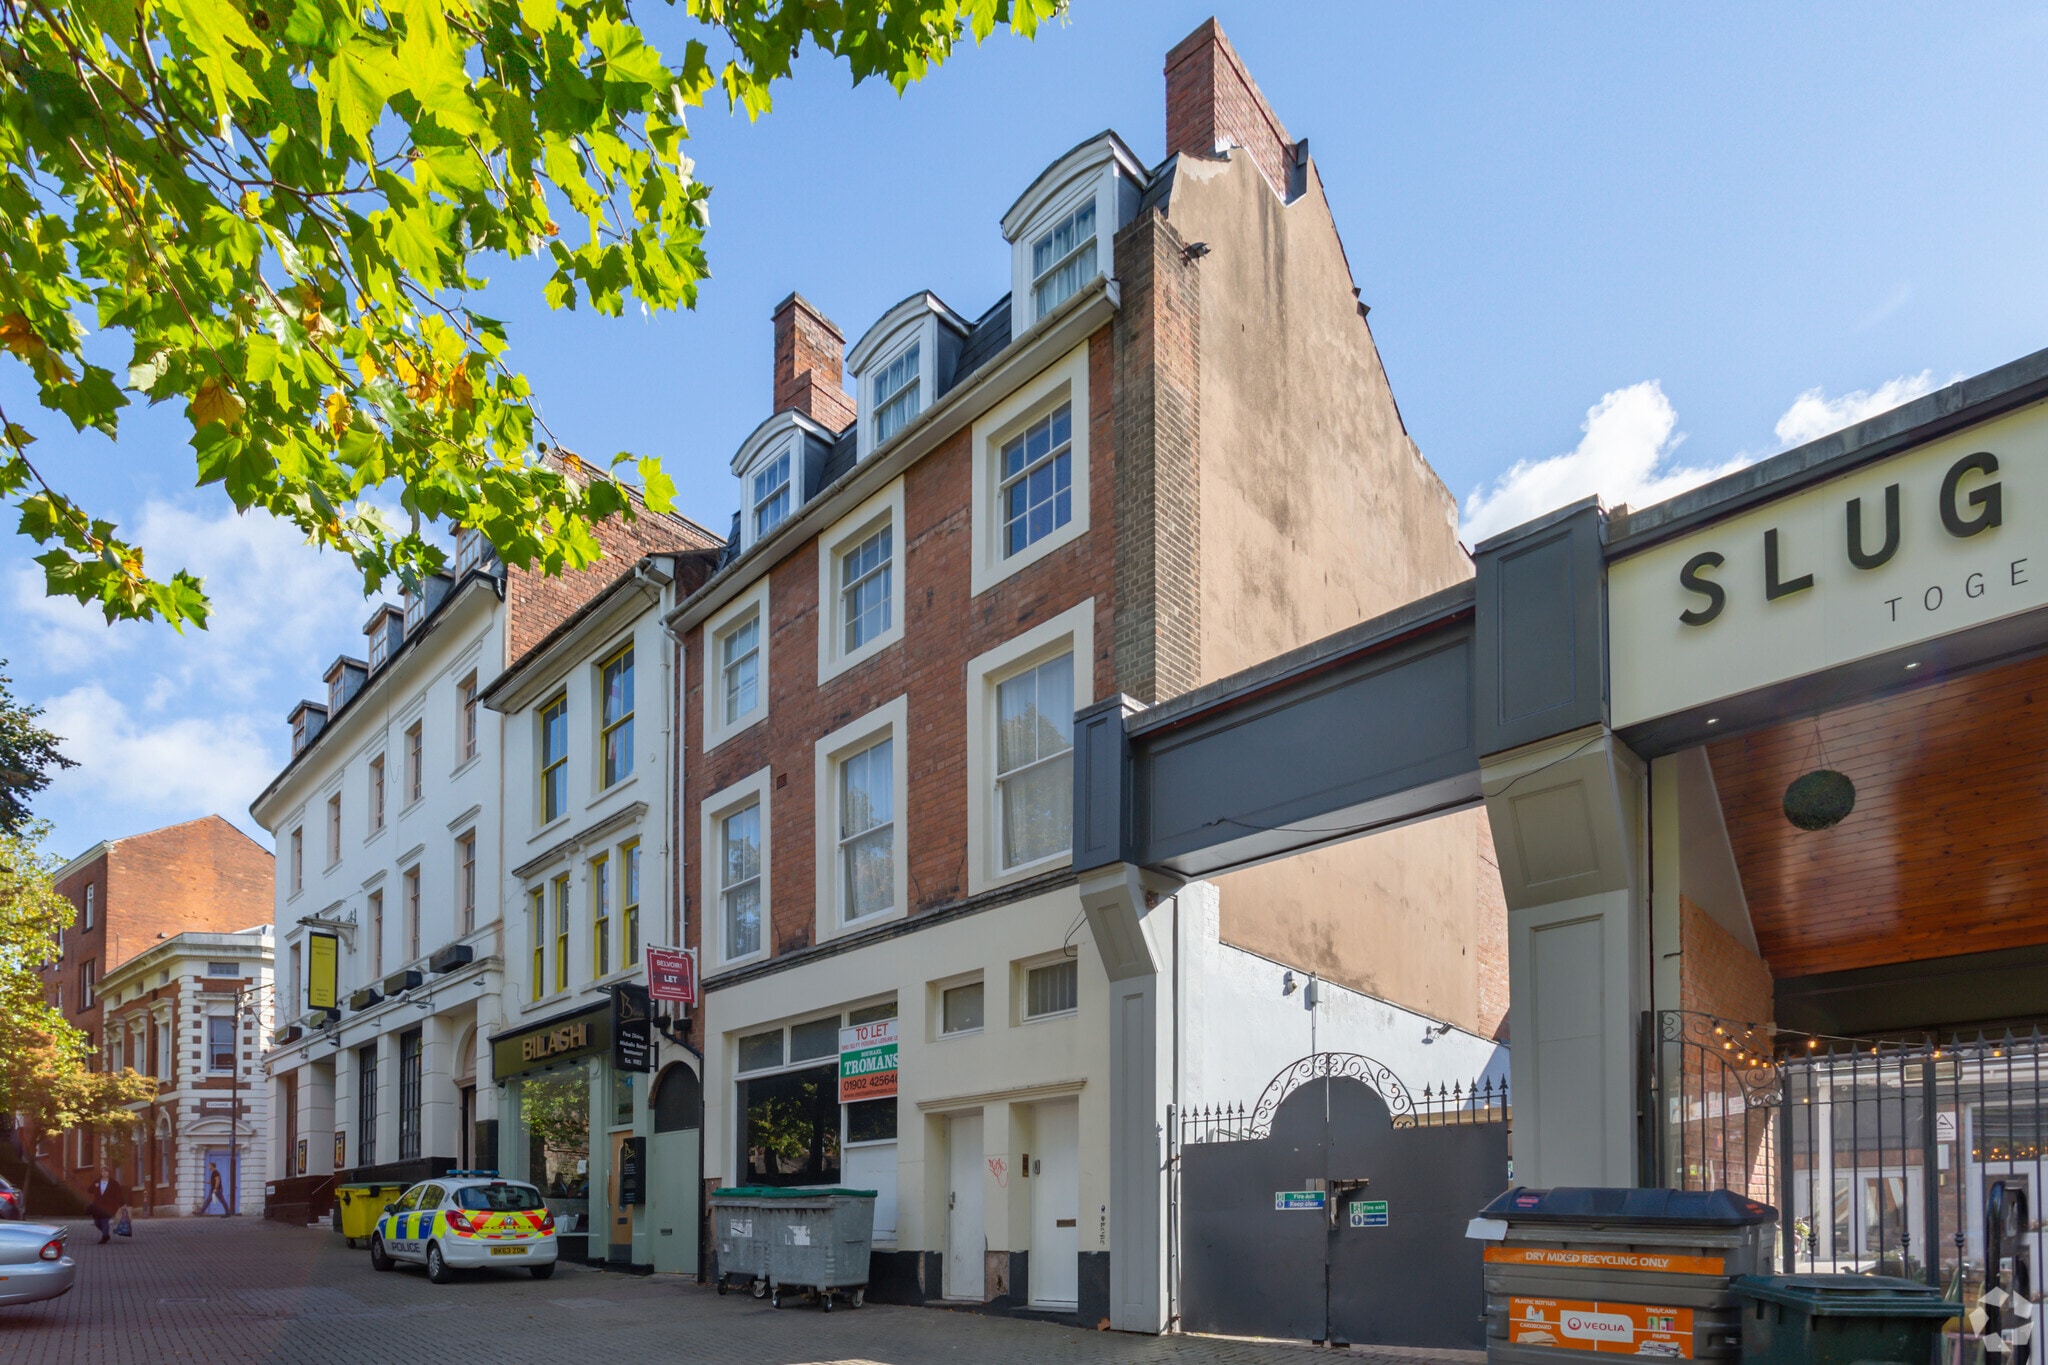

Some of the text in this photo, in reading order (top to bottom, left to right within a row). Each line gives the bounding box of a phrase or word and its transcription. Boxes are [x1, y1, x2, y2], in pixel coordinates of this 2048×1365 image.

[1678, 451, 2003, 628] SLUG
[1884, 558, 2029, 623] TOGE
[664, 974, 678, 983] LET
[856, 1023, 888, 1040] TO LET
[522, 1022, 587, 1061] BILASH
[844, 1053, 898, 1075] TROMANS
[843, 1078, 867, 1091] 01902
[391, 1241, 421, 1253] POLICE
[1525, 1252, 1545, 1262] DRY
[1581, 1254, 1638, 1267] RECYCLING
[1639, 1257, 1669, 1268] ONLY
[1645, 1307, 1678, 1315] TINS/CANS
[1519, 1322, 1552, 1330] CARDBOARD
[1583, 1321, 1625, 1332] VEOLIA
